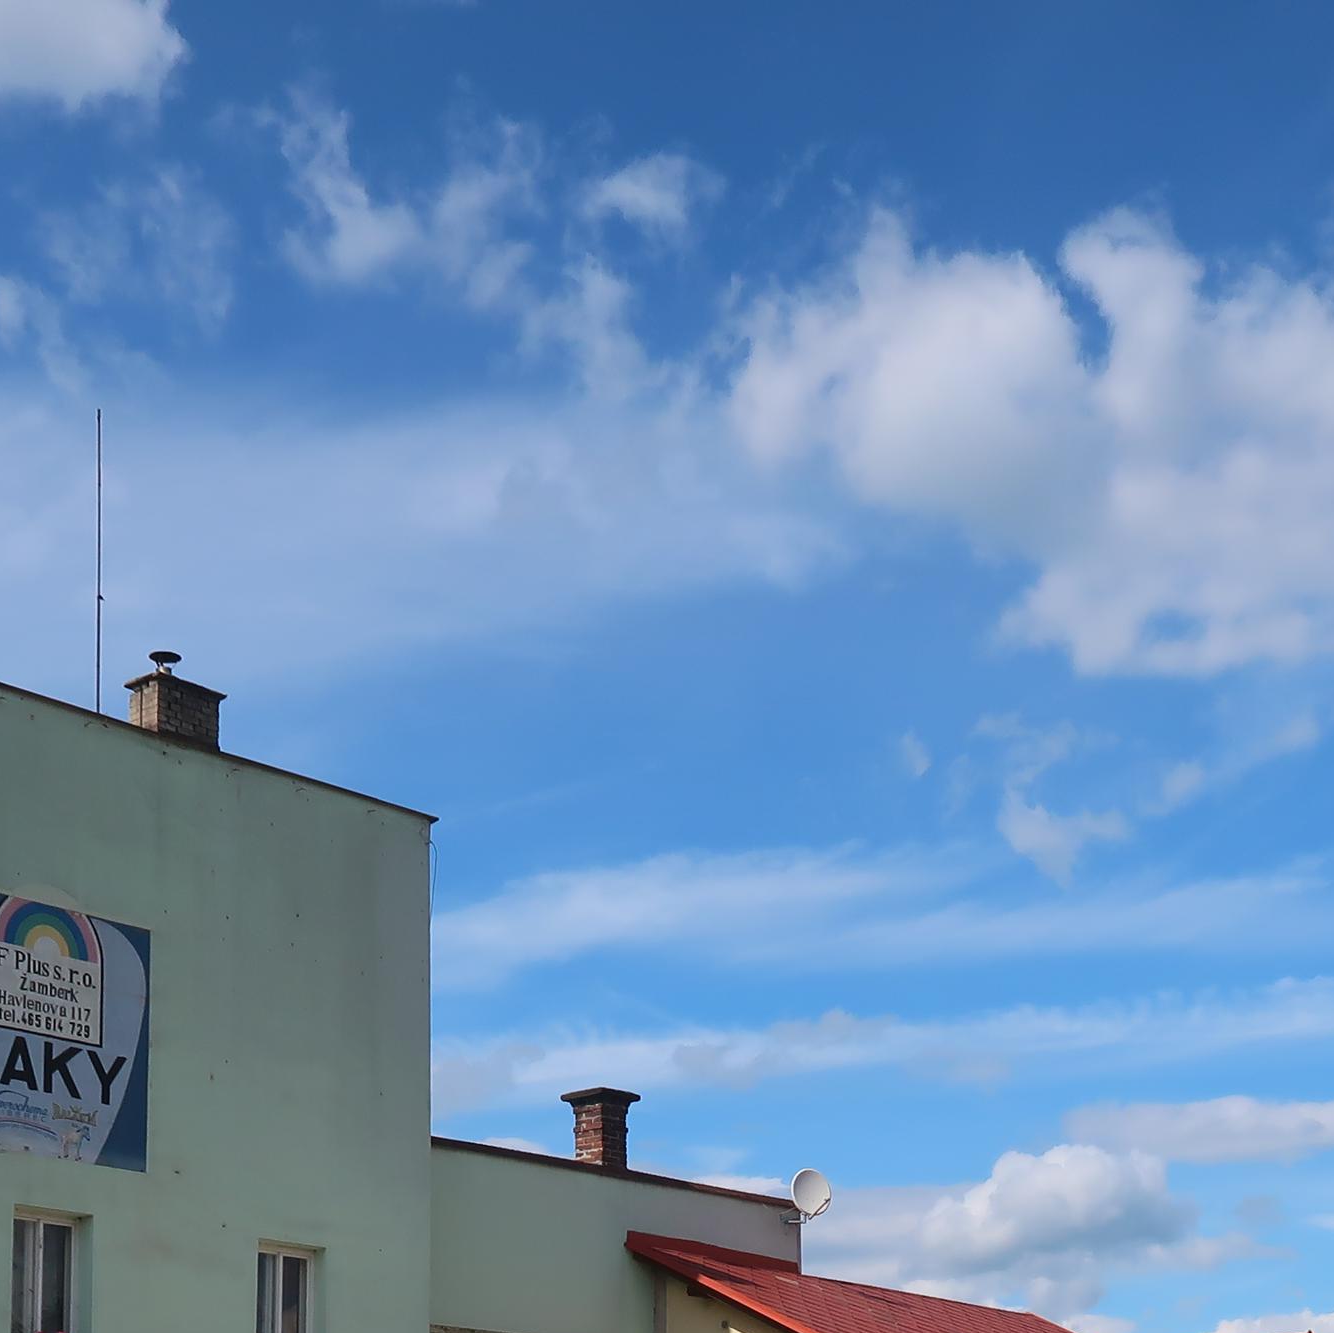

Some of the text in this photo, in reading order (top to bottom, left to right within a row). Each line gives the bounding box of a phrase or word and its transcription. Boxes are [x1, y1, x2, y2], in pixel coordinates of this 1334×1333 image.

[14, 949, 50, 981] Plus
[20, 974, 79, 1003] Žamberk
[45, 1015, 65, 1034] 614
[69, 1020, 91, 1039] 729
[71, 1007, 91, 1022] 117
